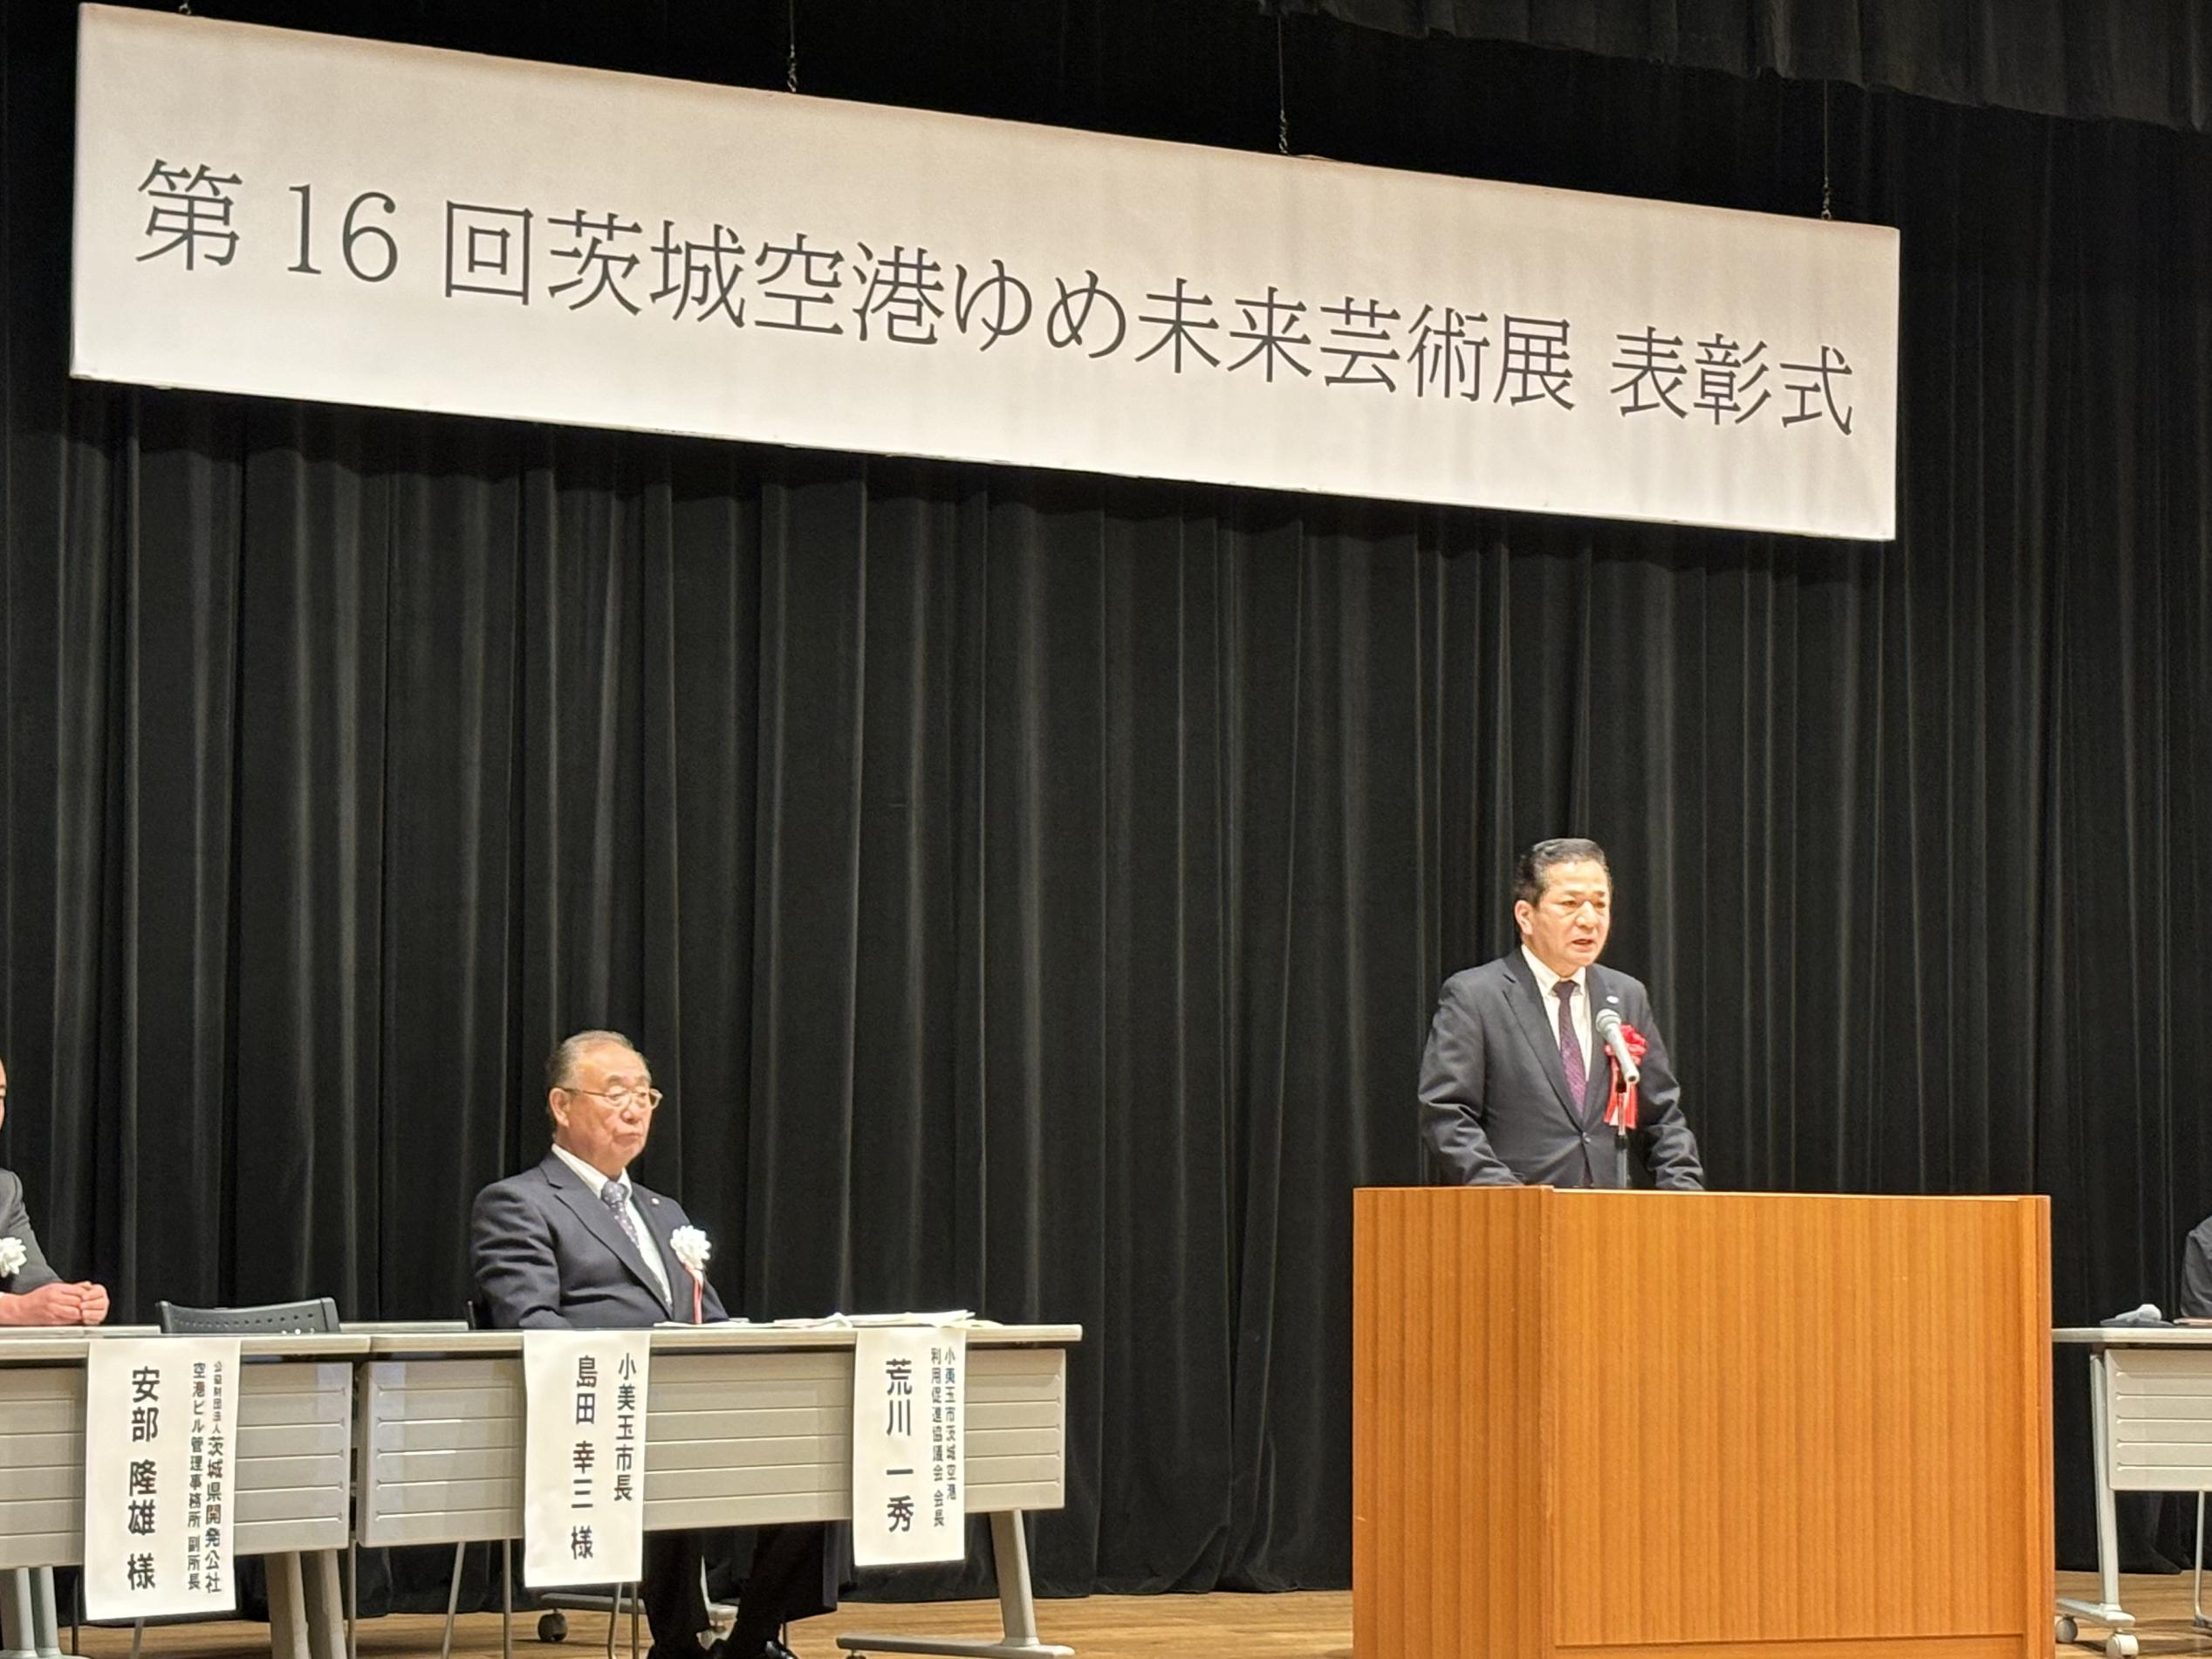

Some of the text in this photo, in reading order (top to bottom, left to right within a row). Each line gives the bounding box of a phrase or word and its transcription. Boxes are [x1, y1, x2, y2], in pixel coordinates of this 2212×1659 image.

[135, 158, 1853, 436] 第 16 回茨城空港ゆめ未来芸術展 表彰式
[127, 1365, 161, 1591] 安部 隆雄 様
[571, 1354, 599, 1560] 島田 幸三 様
[613, 1352, 637, 1502] 小美玉市長
[885, 1358, 914, 1533] 荒川 一秀
